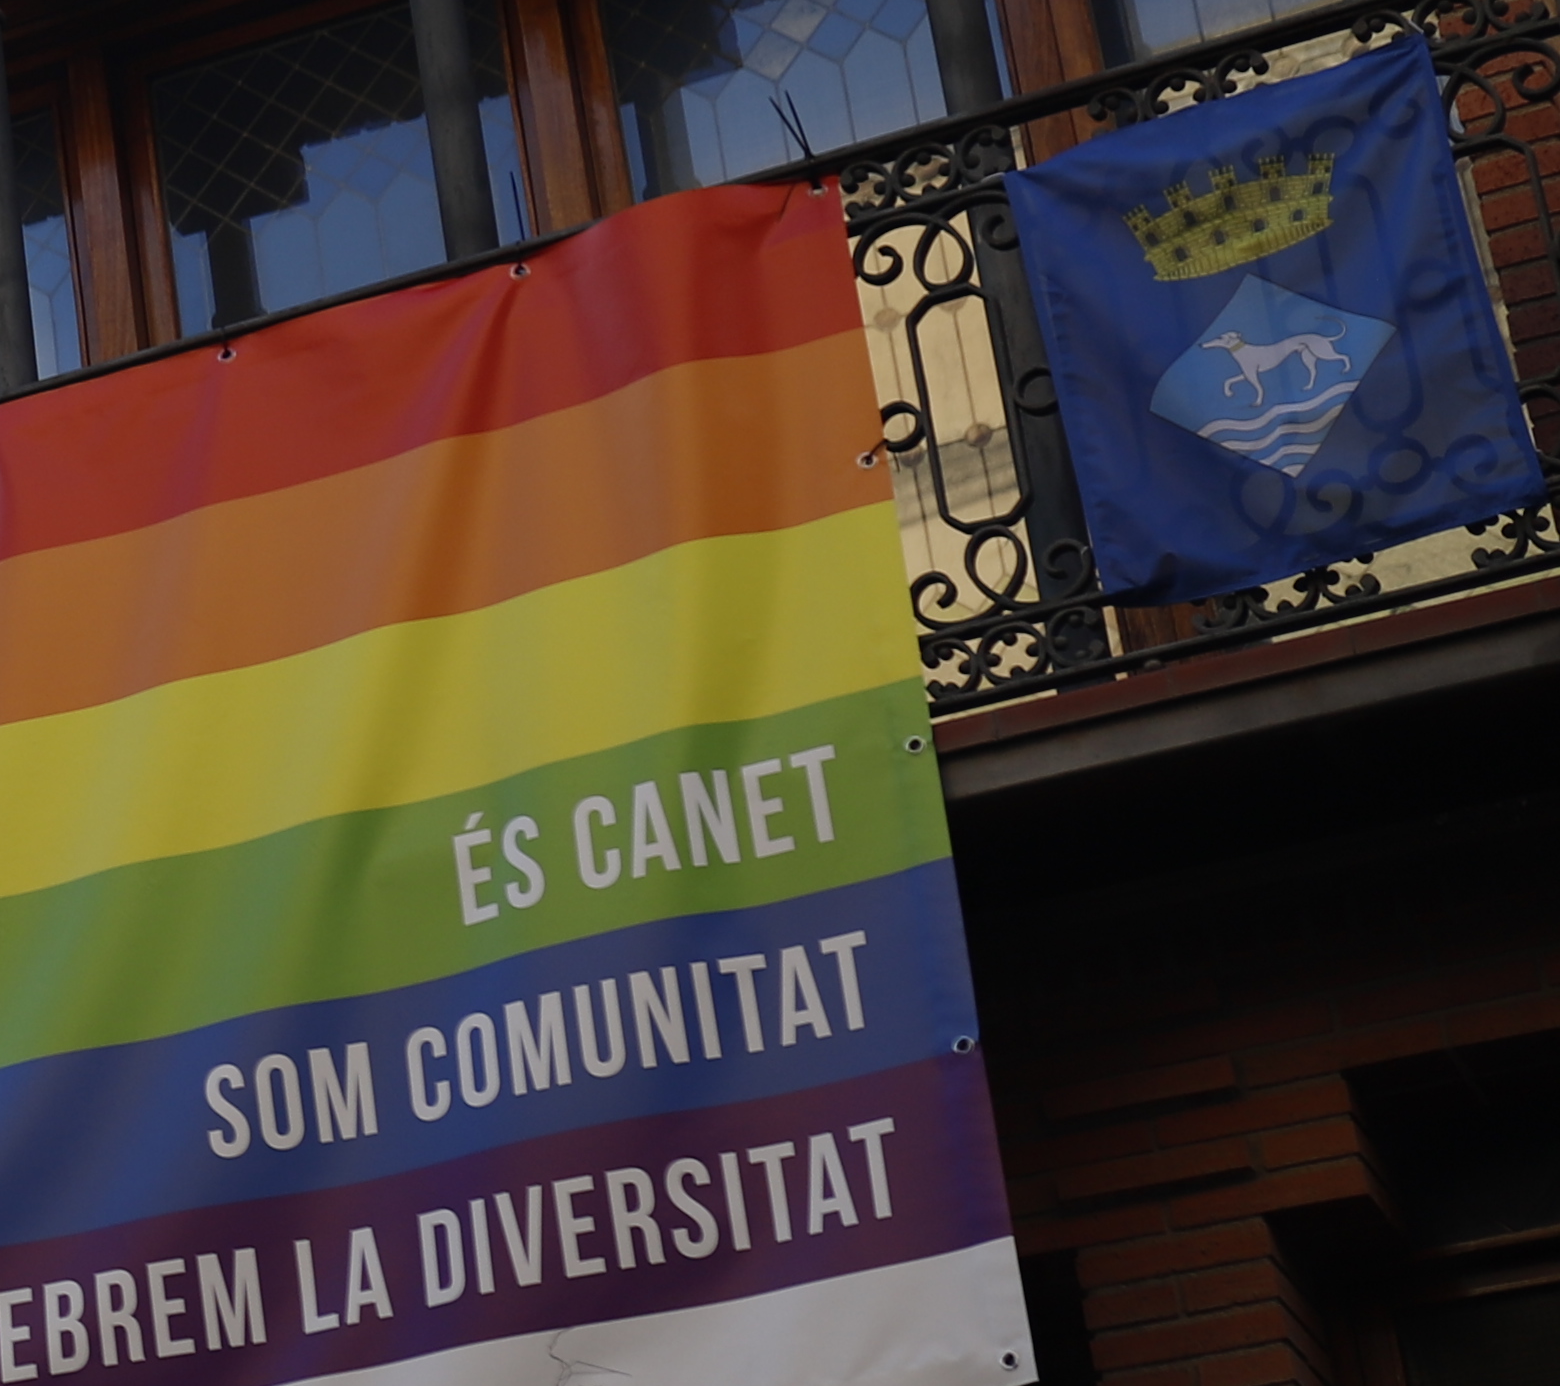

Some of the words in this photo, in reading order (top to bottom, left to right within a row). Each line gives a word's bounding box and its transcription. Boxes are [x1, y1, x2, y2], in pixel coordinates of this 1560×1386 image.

[452, 810, 546, 926] ÉS
[573, 743, 836, 890] CANET
[204, 1041, 379, 1159] SOM
[406, 929, 868, 1123] COMUNITAT
[295, 1226, 393, 1335] LA
[417, 1117, 898, 1309] DIVERSITAT
